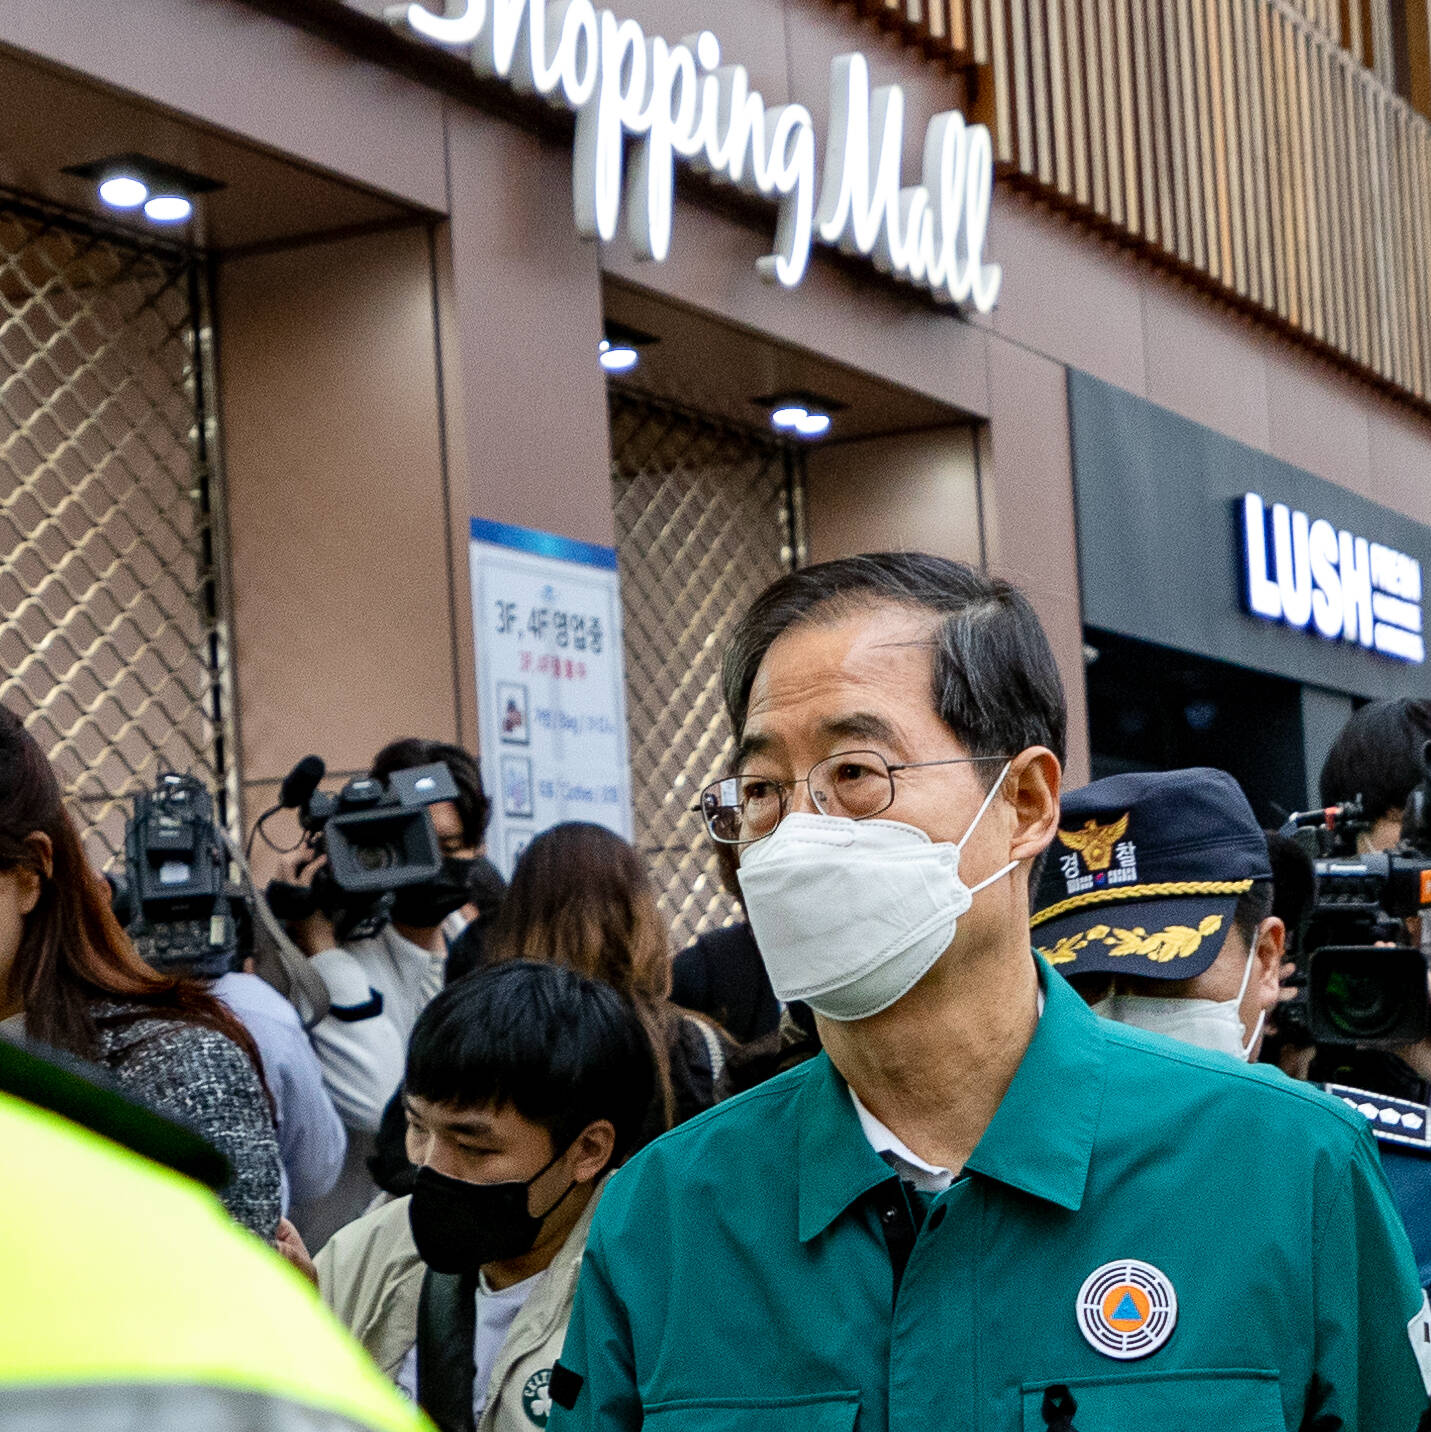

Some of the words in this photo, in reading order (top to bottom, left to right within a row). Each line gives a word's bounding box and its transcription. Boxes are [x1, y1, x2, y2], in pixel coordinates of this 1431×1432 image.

[408, 0, 815, 286] opping
[819, 51, 1002, 314] Mall
[1244, 491, 1374, 649] LUSH
